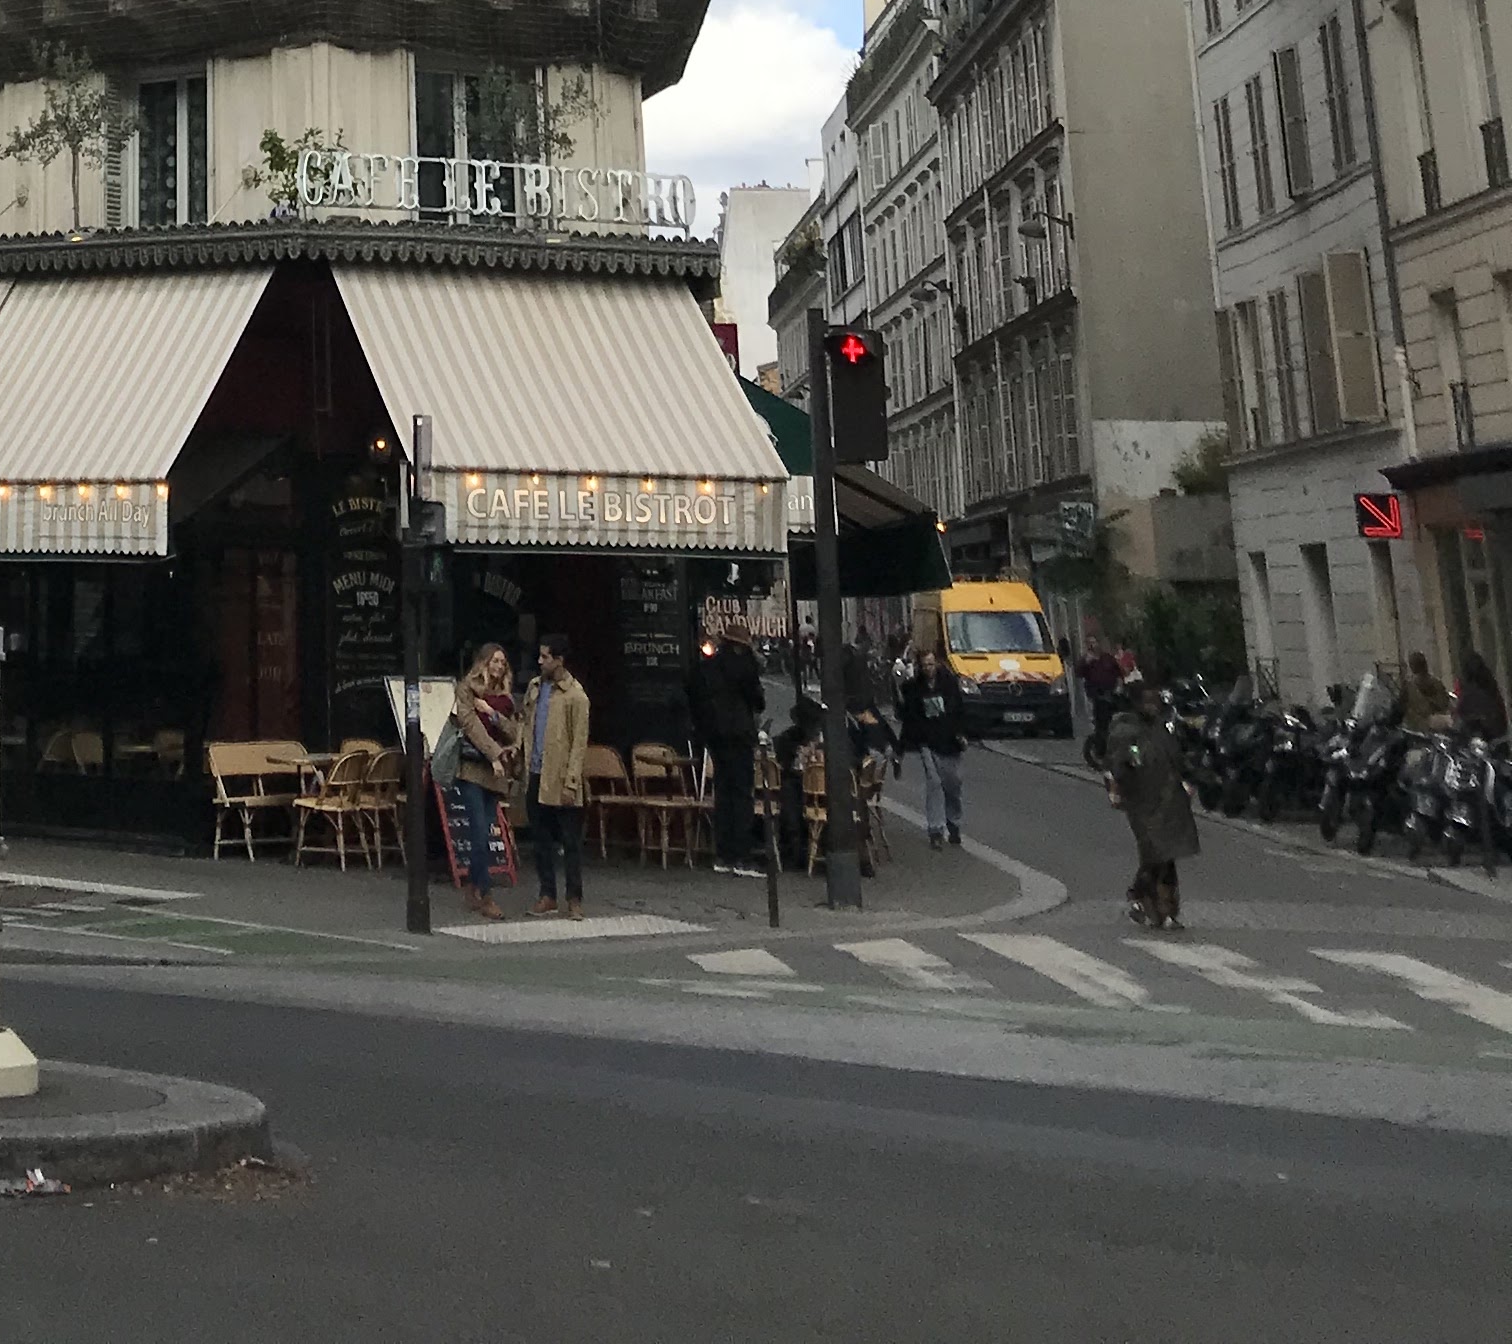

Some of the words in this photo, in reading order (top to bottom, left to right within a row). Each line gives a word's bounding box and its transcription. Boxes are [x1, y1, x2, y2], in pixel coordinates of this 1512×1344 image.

[298, 149, 420, 210] CAFE
[443, 157, 503, 216] LE
[524, 162, 696, 227] BISTRO
[121, 500, 150, 528] Day
[466, 488, 550, 520] CAFE
[559, 490, 595, 521] LE
[603, 491, 736, 525] BISTROT
[332, 571, 366, 595] MENU
[623, 642, 680, 655] BRUNCH
